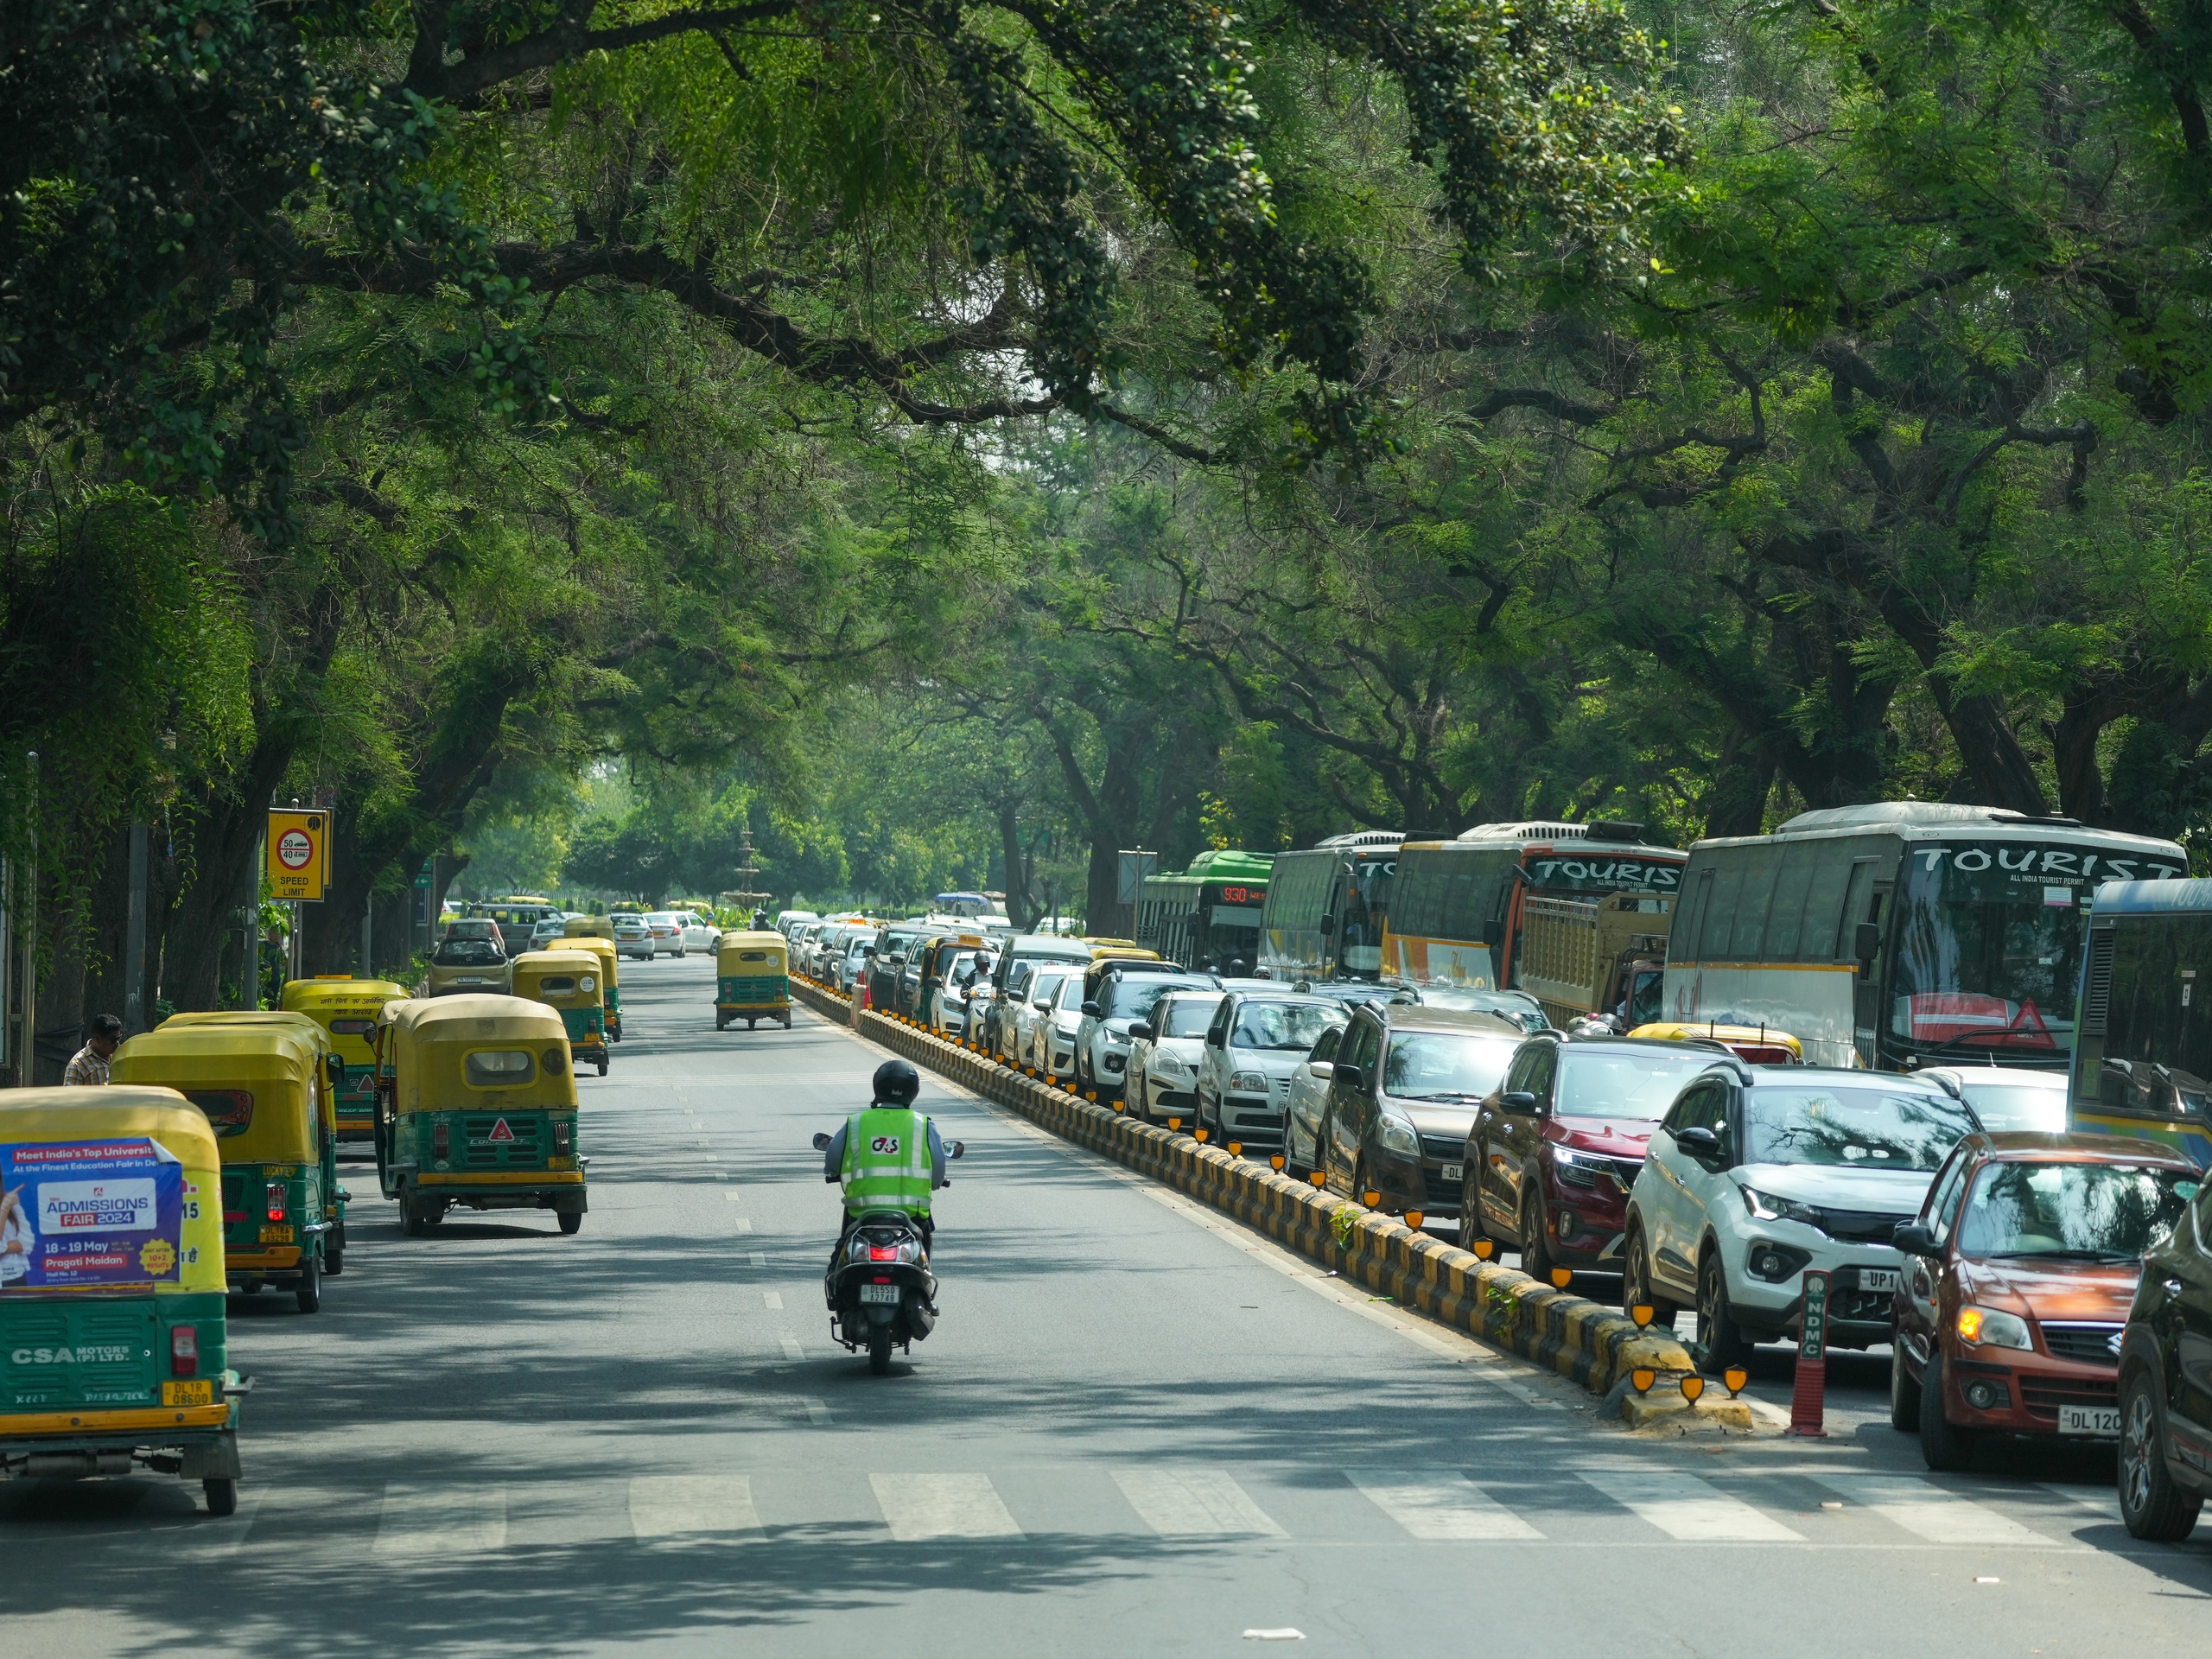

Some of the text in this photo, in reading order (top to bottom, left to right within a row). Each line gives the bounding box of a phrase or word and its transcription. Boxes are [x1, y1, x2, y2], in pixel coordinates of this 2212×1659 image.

[283, 839, 293, 848] 50
[283, 850, 293, 859] 40
[1913, 848, 2182, 881] TOURIST
[1536, 861, 1680, 885] TOURIS
[280, 876, 308, 886] SPEED
[2022, 874, 2037, 883] INDIA
[2038, 875, 2063, 884] TOURIST
[2063, 877, 2085, 886] PERMIT
[1224, 887, 1247, 903] 930
[872, 1137, 898, 1154] G4S
[16, 1151, 44, 1160] Meet
[46, 1148, 81, 1159] India's
[82, 1147, 102, 1159] Top
[42, 1163, 69, 1172] Finest
[71, 1160, 115, 1170] Education
[116, 1160, 133, 1168] Fair
[263, 1166, 283, 1176] LUCKY
[47, 1198, 149, 1213] ADMISSIONS
[63, 1212, 133, 1225] FAIR 2024
[45, 1243, 59, 1254] 18
[68, 1242, 83, 1253] 19
[84, 1241, 109, 1254] May
[46, 1256, 123, 1269] Pragati Maidan
[870, 1285, 895, 1294] DL5SD
[1805, 1302, 1821, 1355] NDMC
[11, 1345, 130, 1364] CSA MOTORS
[76, 1353, 130, 1363] (P) LTD.
[175, 1382, 202, 1394] DL1R
